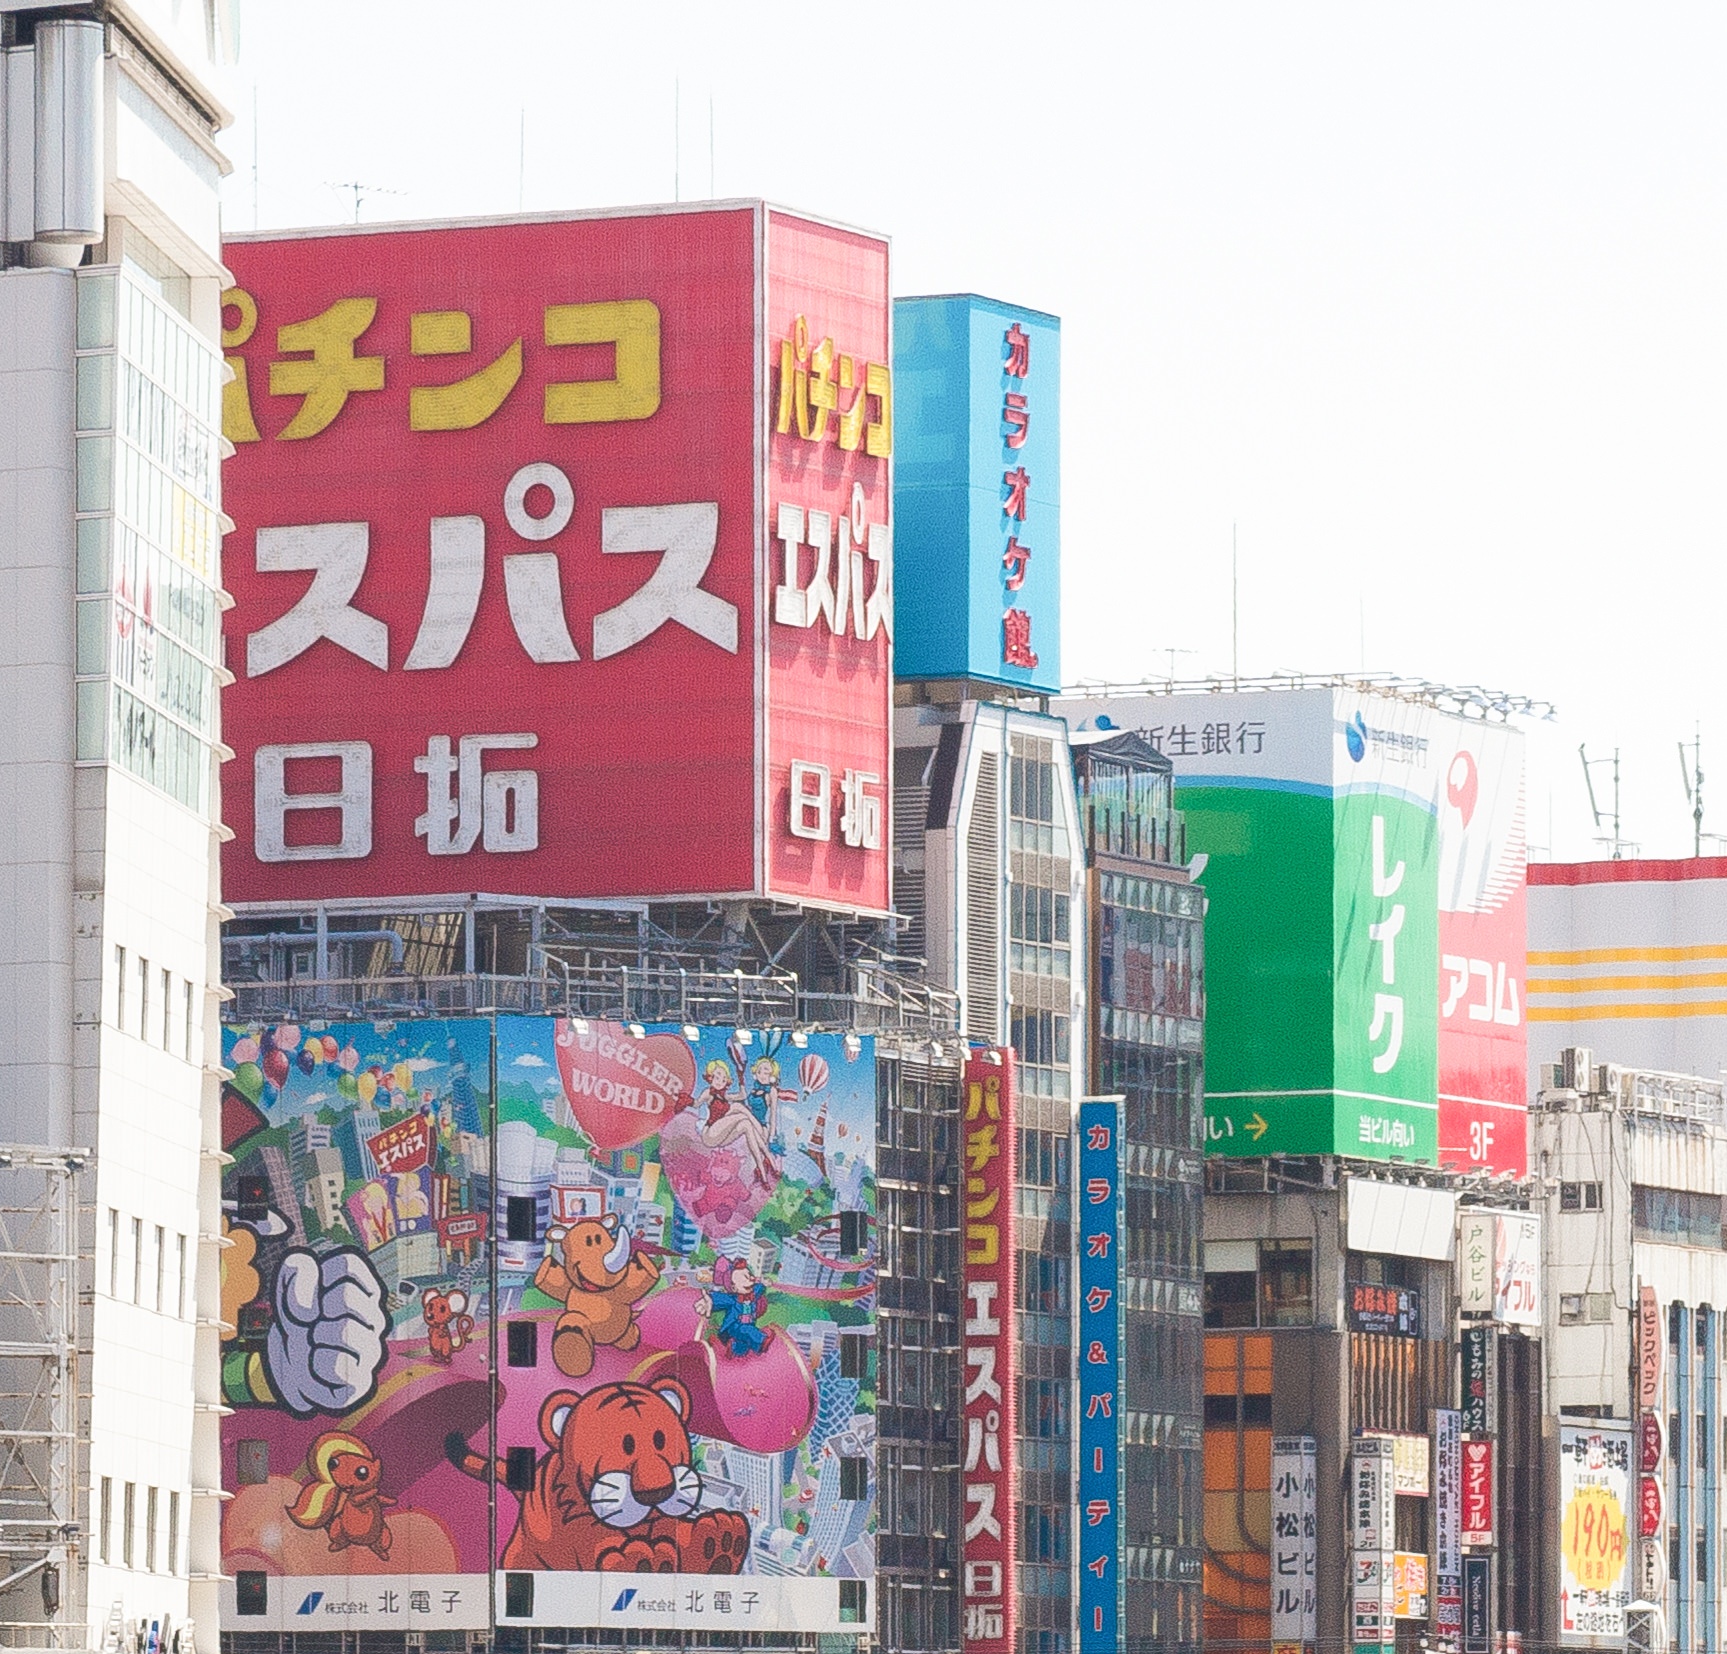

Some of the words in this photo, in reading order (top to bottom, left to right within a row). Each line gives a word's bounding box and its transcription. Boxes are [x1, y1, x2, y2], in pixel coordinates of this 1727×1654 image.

[778, 314, 893, 457] パチンコ
[1003, 323, 1038, 669] カラオケ館
[222, 461, 739, 679] スパス
[776, 481, 893, 642] エスパス
[1369, 816, 1405, 1074] レイク
[1442, 955, 1521, 1027] アコム
[557, 1030, 682, 1094] JUGGLER
[571, 1074, 665, 1117] WORLD
[965, 1076, 1005, 1265] パチンコ
[1470, 1122, 1494, 1161] 3F
[1469, 1225, 1487, 1303] 戸谷ビル
[964, 1283, 1002, 1542] エスパス
[1469, 1463, 1486, 1530] アイフル
[1574, 1503, 1623, 1561] 190円
[1276, 1471, 1299, 1614] 小松ビル
[377, 1589, 462, 1616] 北電子
[685, 1590, 760, 1614] 北電子
